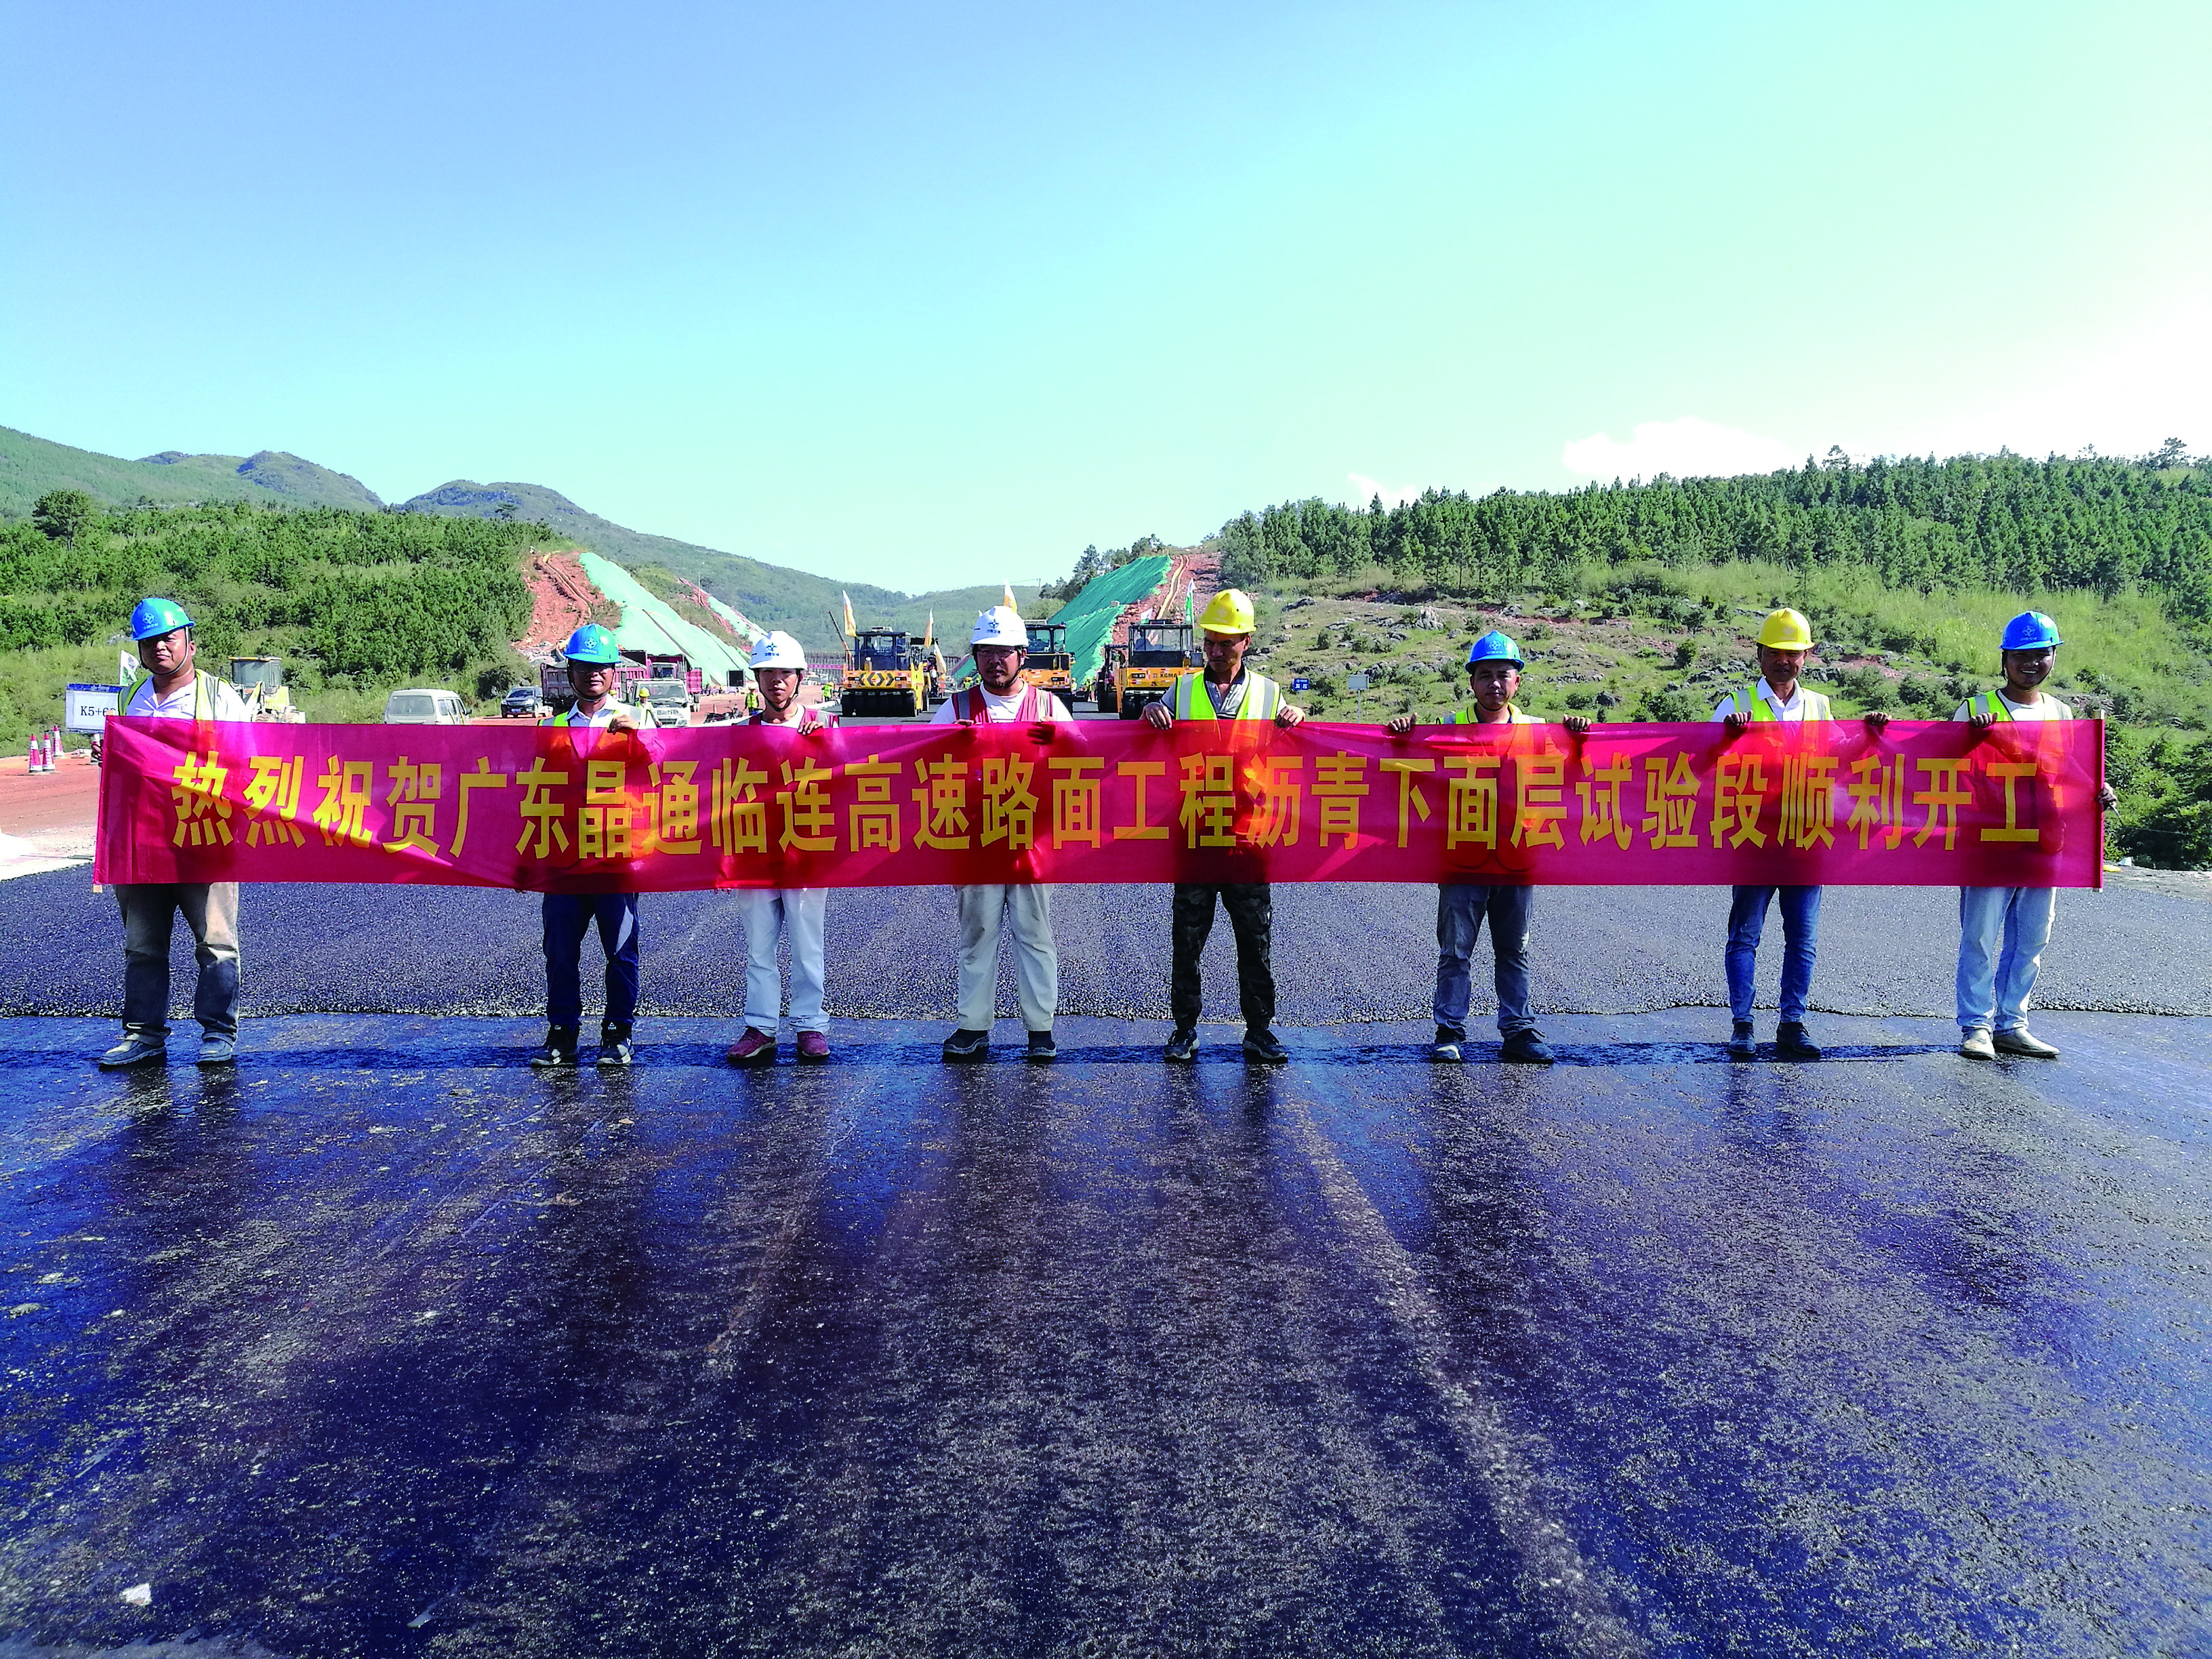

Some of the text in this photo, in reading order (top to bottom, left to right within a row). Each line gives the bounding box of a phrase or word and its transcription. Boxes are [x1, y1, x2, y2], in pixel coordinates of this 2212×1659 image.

[171, 750, 2040, 860] 热烈祝贺广东晶通临连高速路面工程沥青下面层试验段顺利开工
